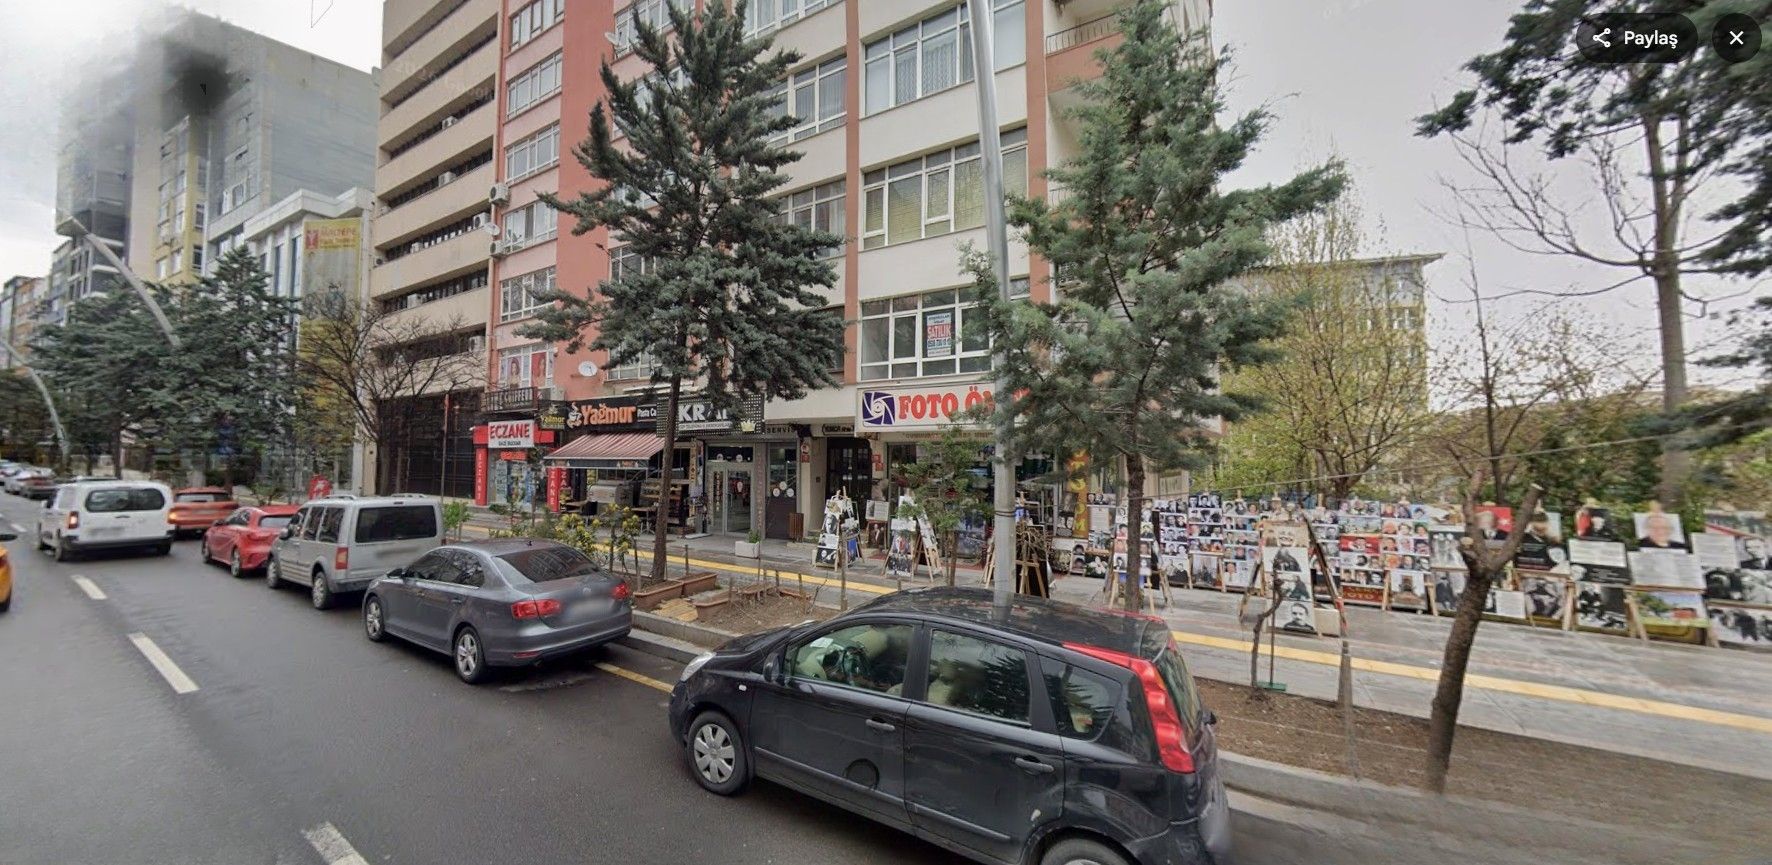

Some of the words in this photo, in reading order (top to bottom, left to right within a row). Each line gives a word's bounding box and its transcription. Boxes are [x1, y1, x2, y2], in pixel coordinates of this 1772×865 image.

[928, 324, 951, 339] SATILIK
[581, 403, 636, 425] Yağmur
[899, 392, 959, 419] FOTO
[490, 423, 530, 439] ECZANE
